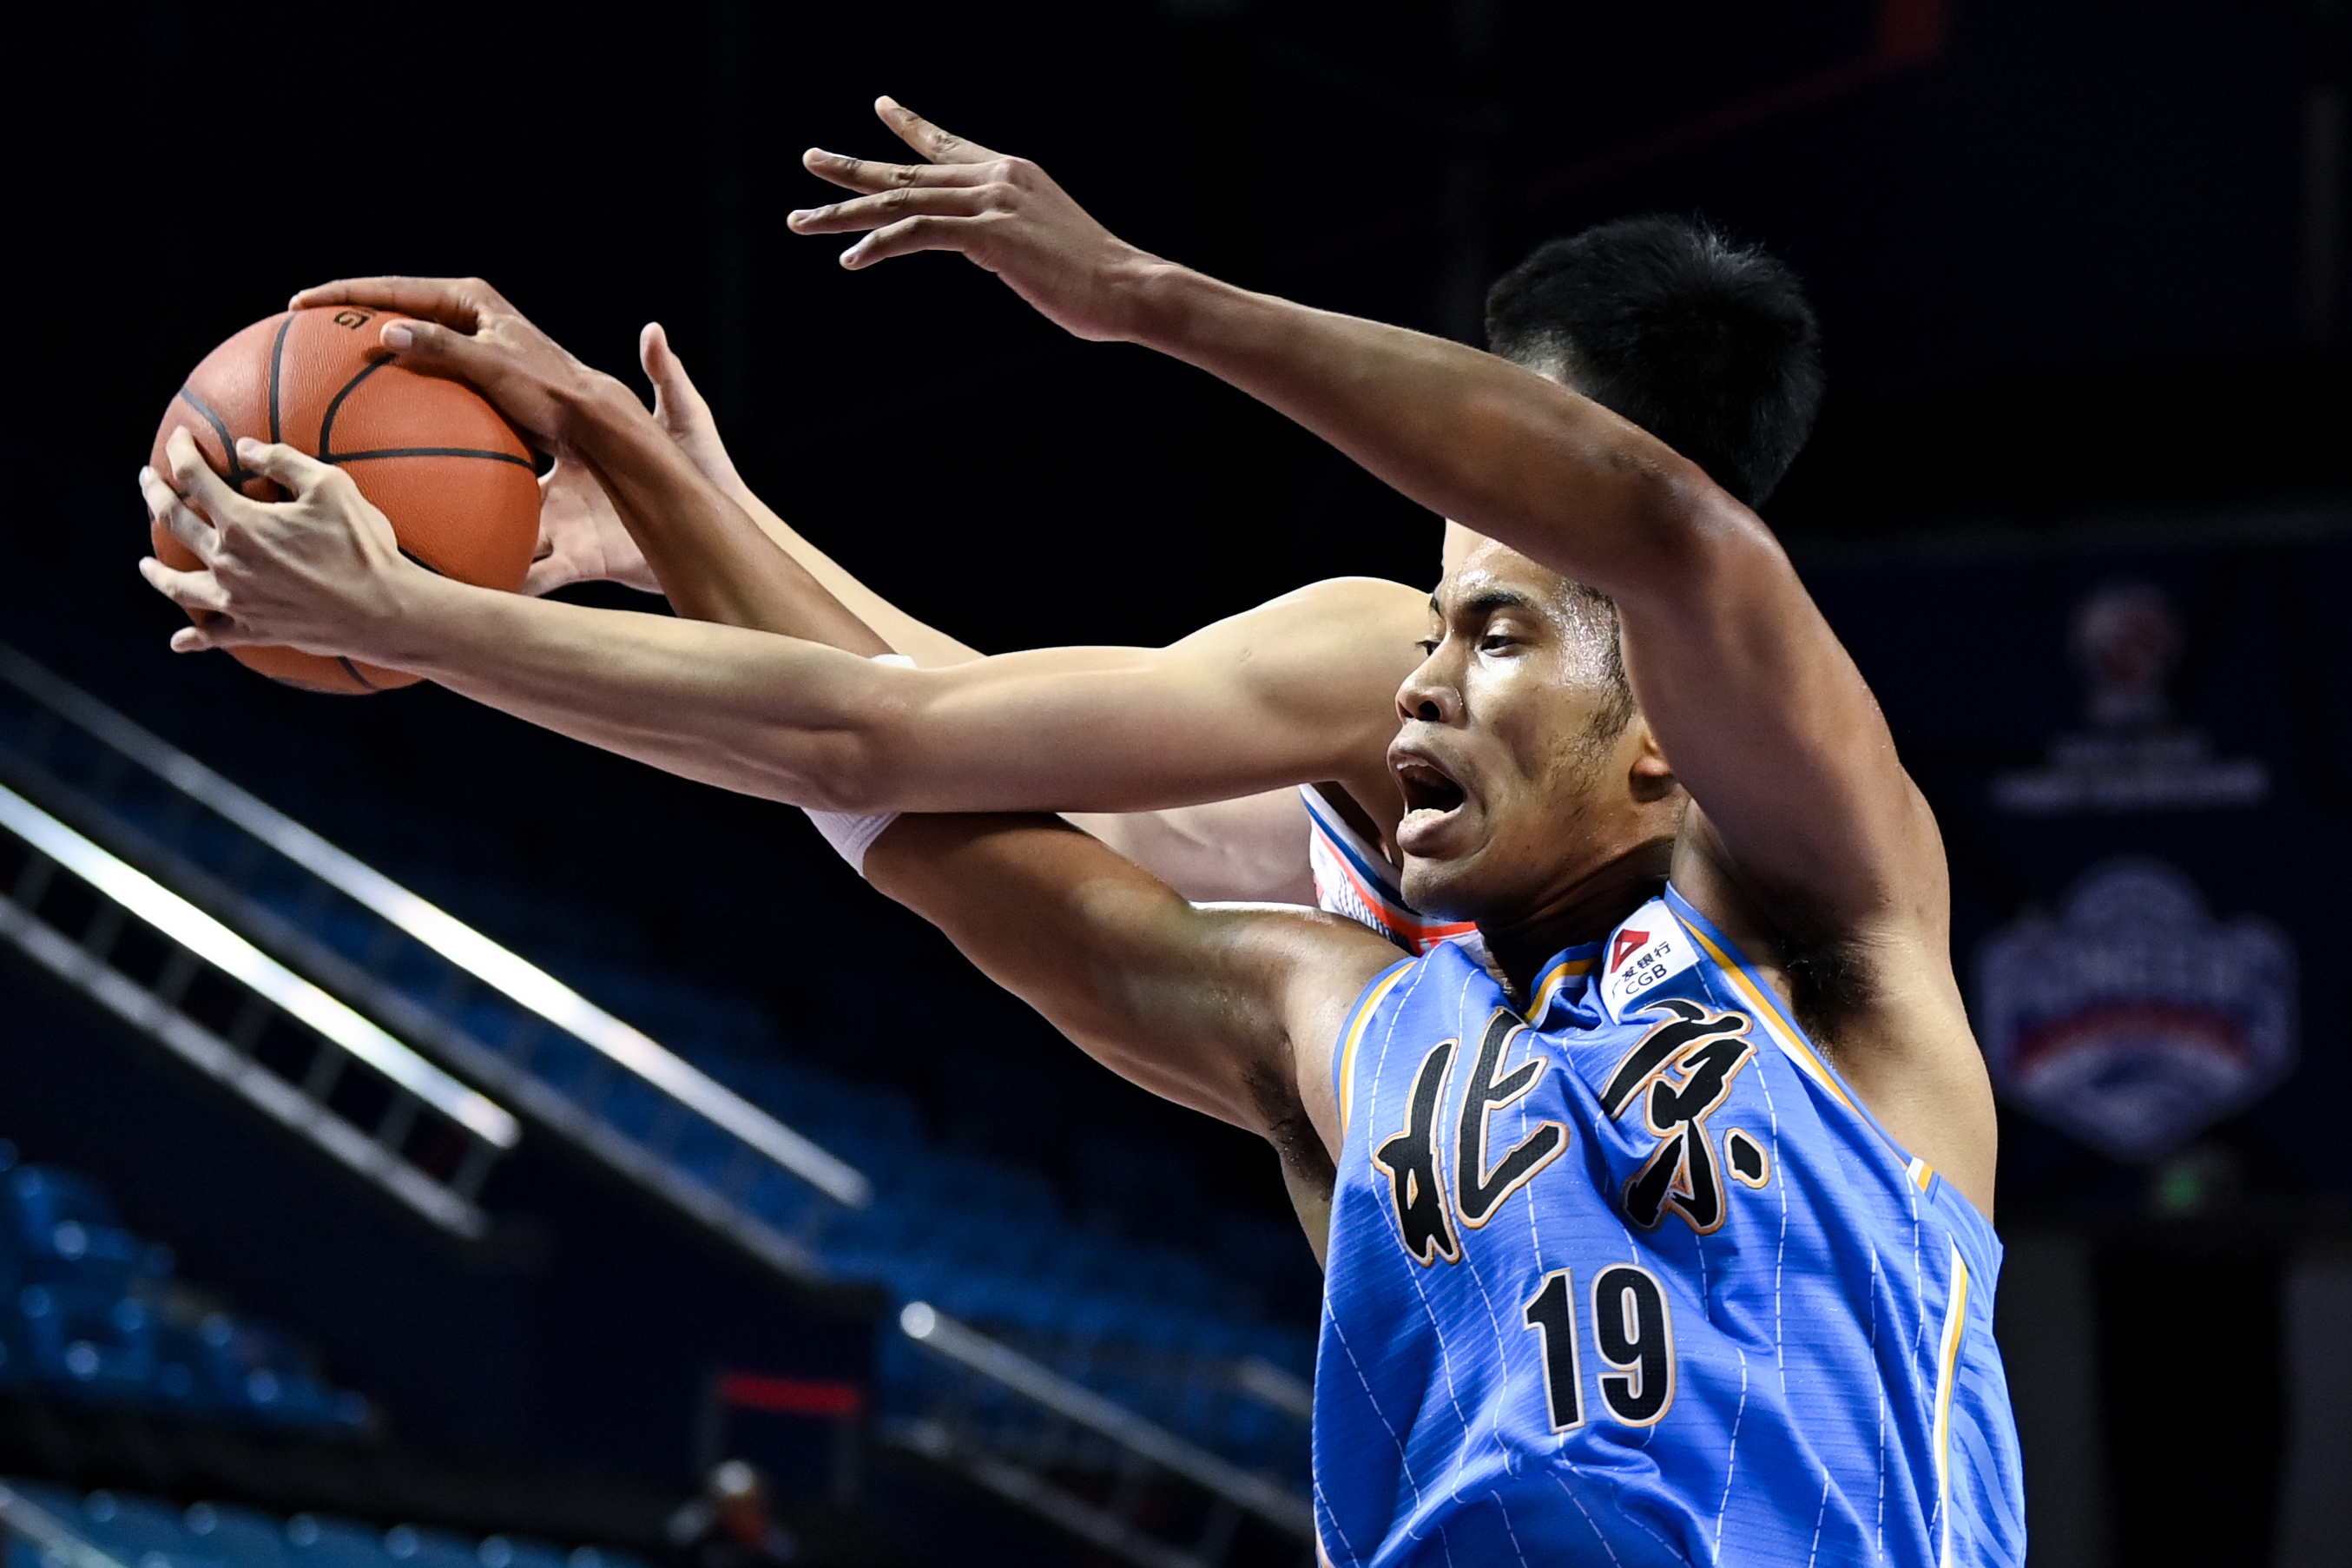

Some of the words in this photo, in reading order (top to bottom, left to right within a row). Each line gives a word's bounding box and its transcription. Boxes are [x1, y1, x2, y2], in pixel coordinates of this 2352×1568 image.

[1625, 964, 1668, 995] CGB
[1371, 998, 1769, 1268] 北京
[1522, 1262, 1677, 1434] 19
